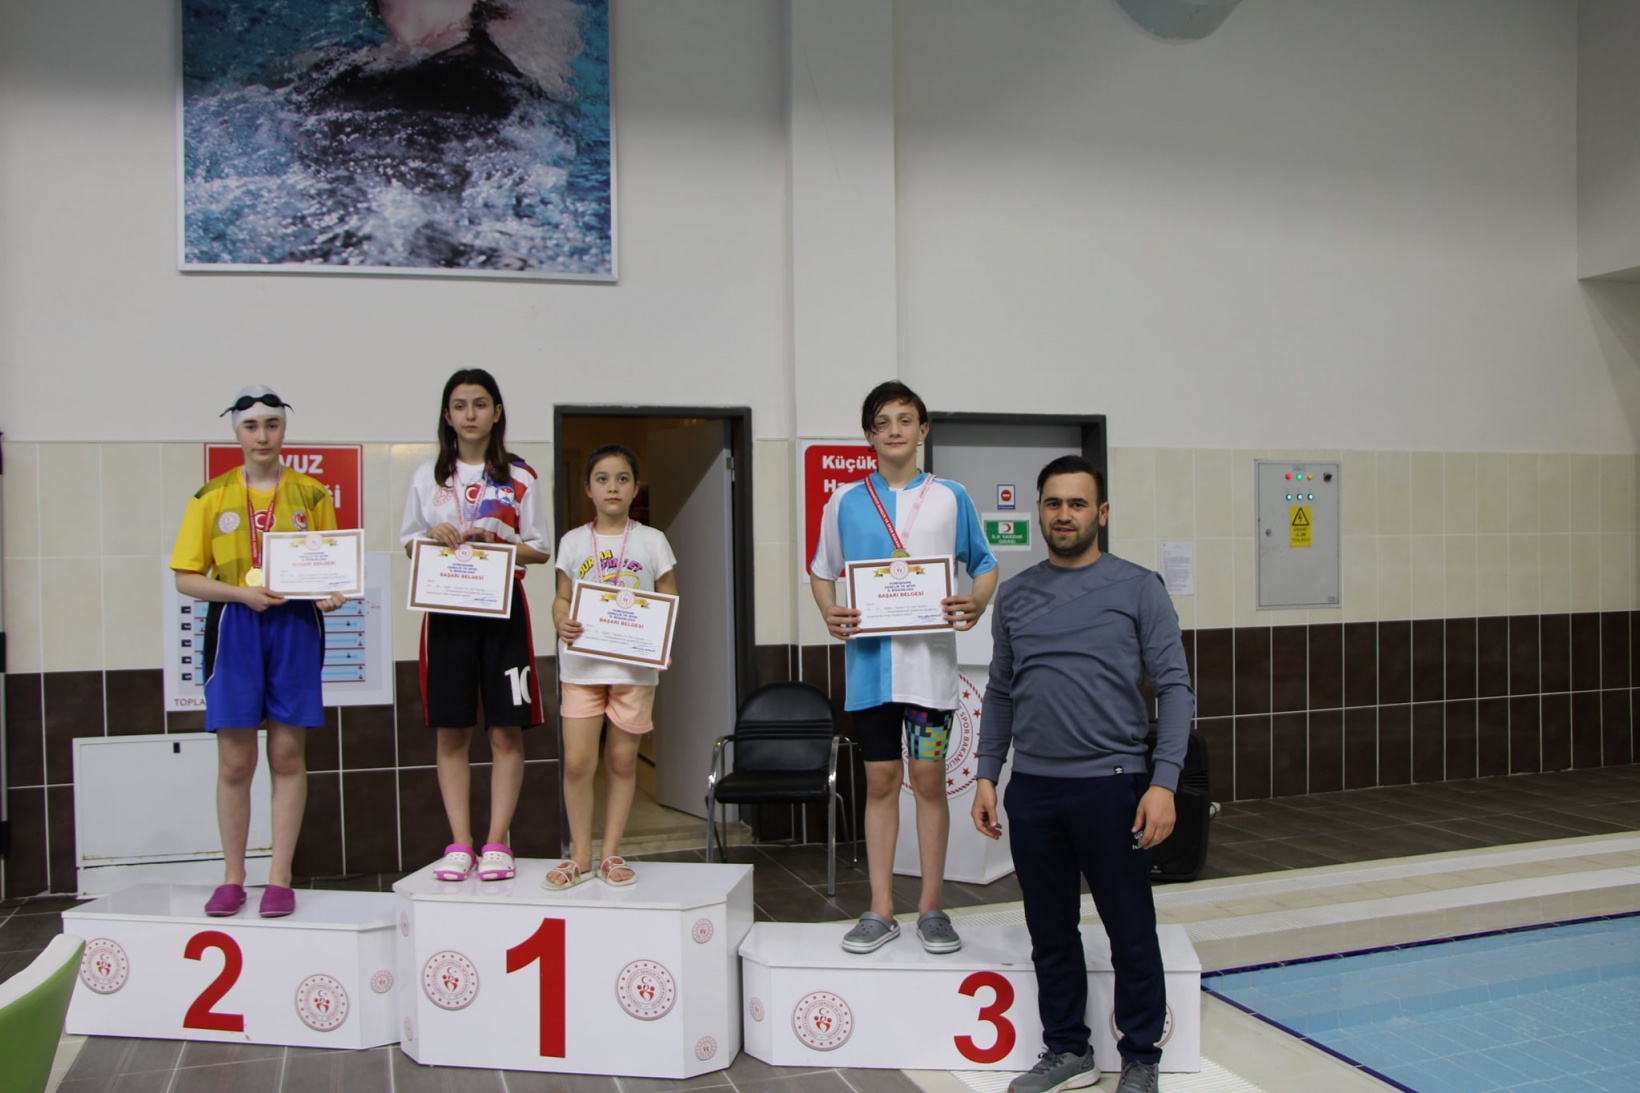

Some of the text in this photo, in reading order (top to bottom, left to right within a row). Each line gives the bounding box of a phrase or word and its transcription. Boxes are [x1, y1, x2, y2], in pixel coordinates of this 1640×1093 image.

[279, 454, 323, 474] VUZ
[822, 455, 877, 473] Küçük
[599, 617, 620, 625] BAŞARI
[174, 698, 206, 706] TOPLA
[945, 711, 970, 771] SPOR BAKANLI
[183, 930, 244, 1032] 2
[506, 917, 566, 1058] 1
[953, 970, 1016, 1064] 3
